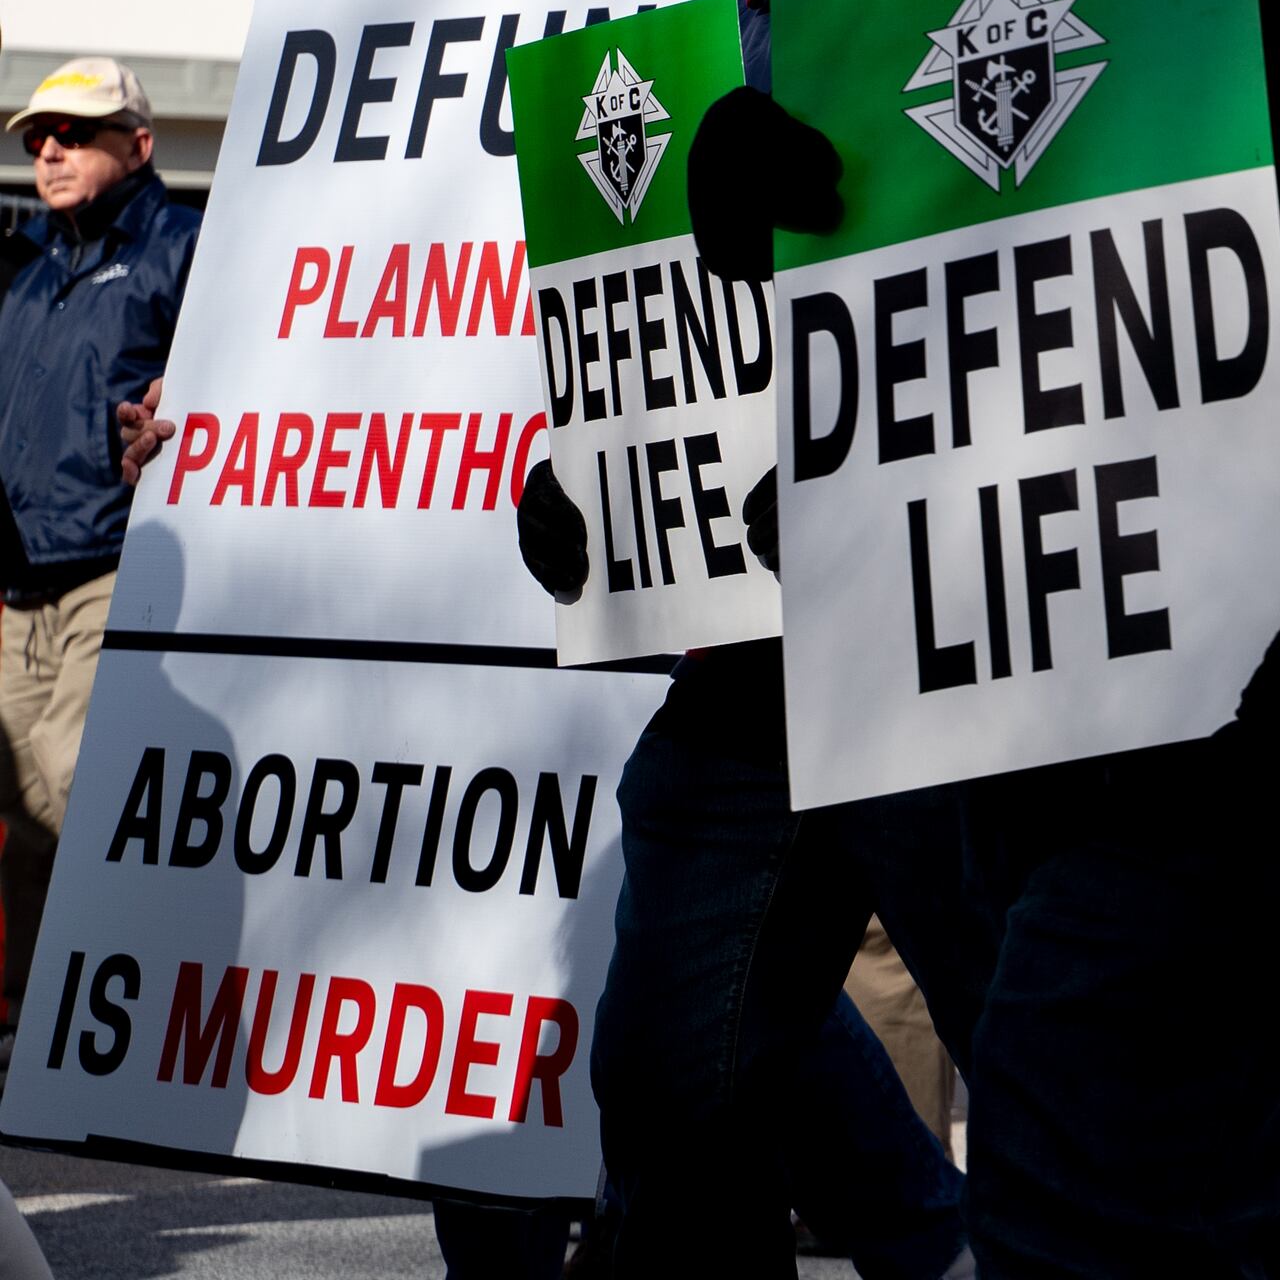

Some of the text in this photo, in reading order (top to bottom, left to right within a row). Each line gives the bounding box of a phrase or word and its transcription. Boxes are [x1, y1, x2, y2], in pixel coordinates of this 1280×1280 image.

[596, 87, 640, 119] K OF C
[957, 8, 1047, 57] K OF C
[277, 240, 536, 339] PLANN
[538, 256, 774, 429] DEFEND
[790, 205, 1270, 484] DEFEND
[597, 431, 748, 594] LIFE
[906, 454, 1173, 694] LIFE
[105, 746, 598, 900] ABORTION
[46, 951, 580, 1129] IS MURDER
